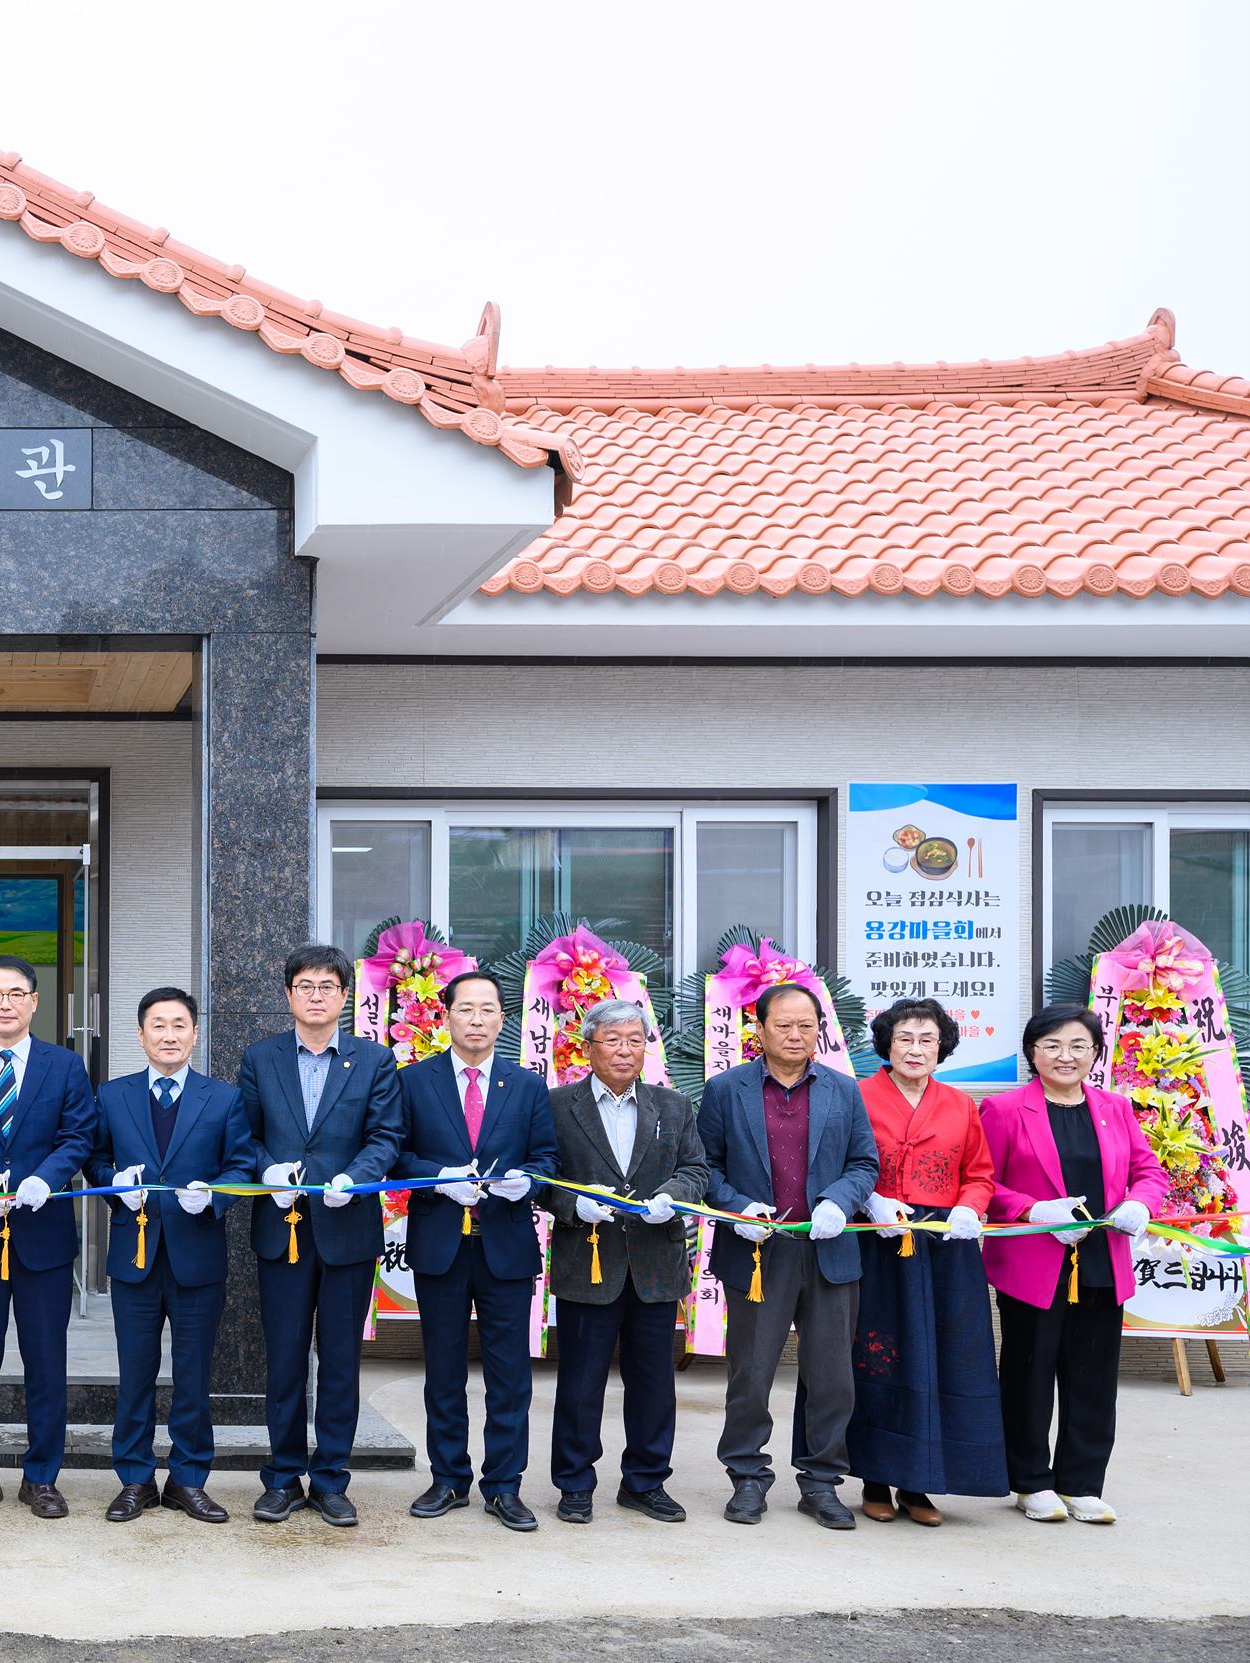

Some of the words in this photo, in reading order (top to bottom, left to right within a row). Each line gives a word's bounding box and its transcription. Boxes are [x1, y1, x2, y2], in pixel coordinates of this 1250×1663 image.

[865, 890, 902, 907] 오늘
[909, 890, 1000, 907] 점심식사는
[865, 951, 1000, 968] 준비하였습니다.
[870, 981, 926, 998] 맛있게
[932, 981, 995, 998] 드세요!
[1192, 996, 1227, 1043] 祝
